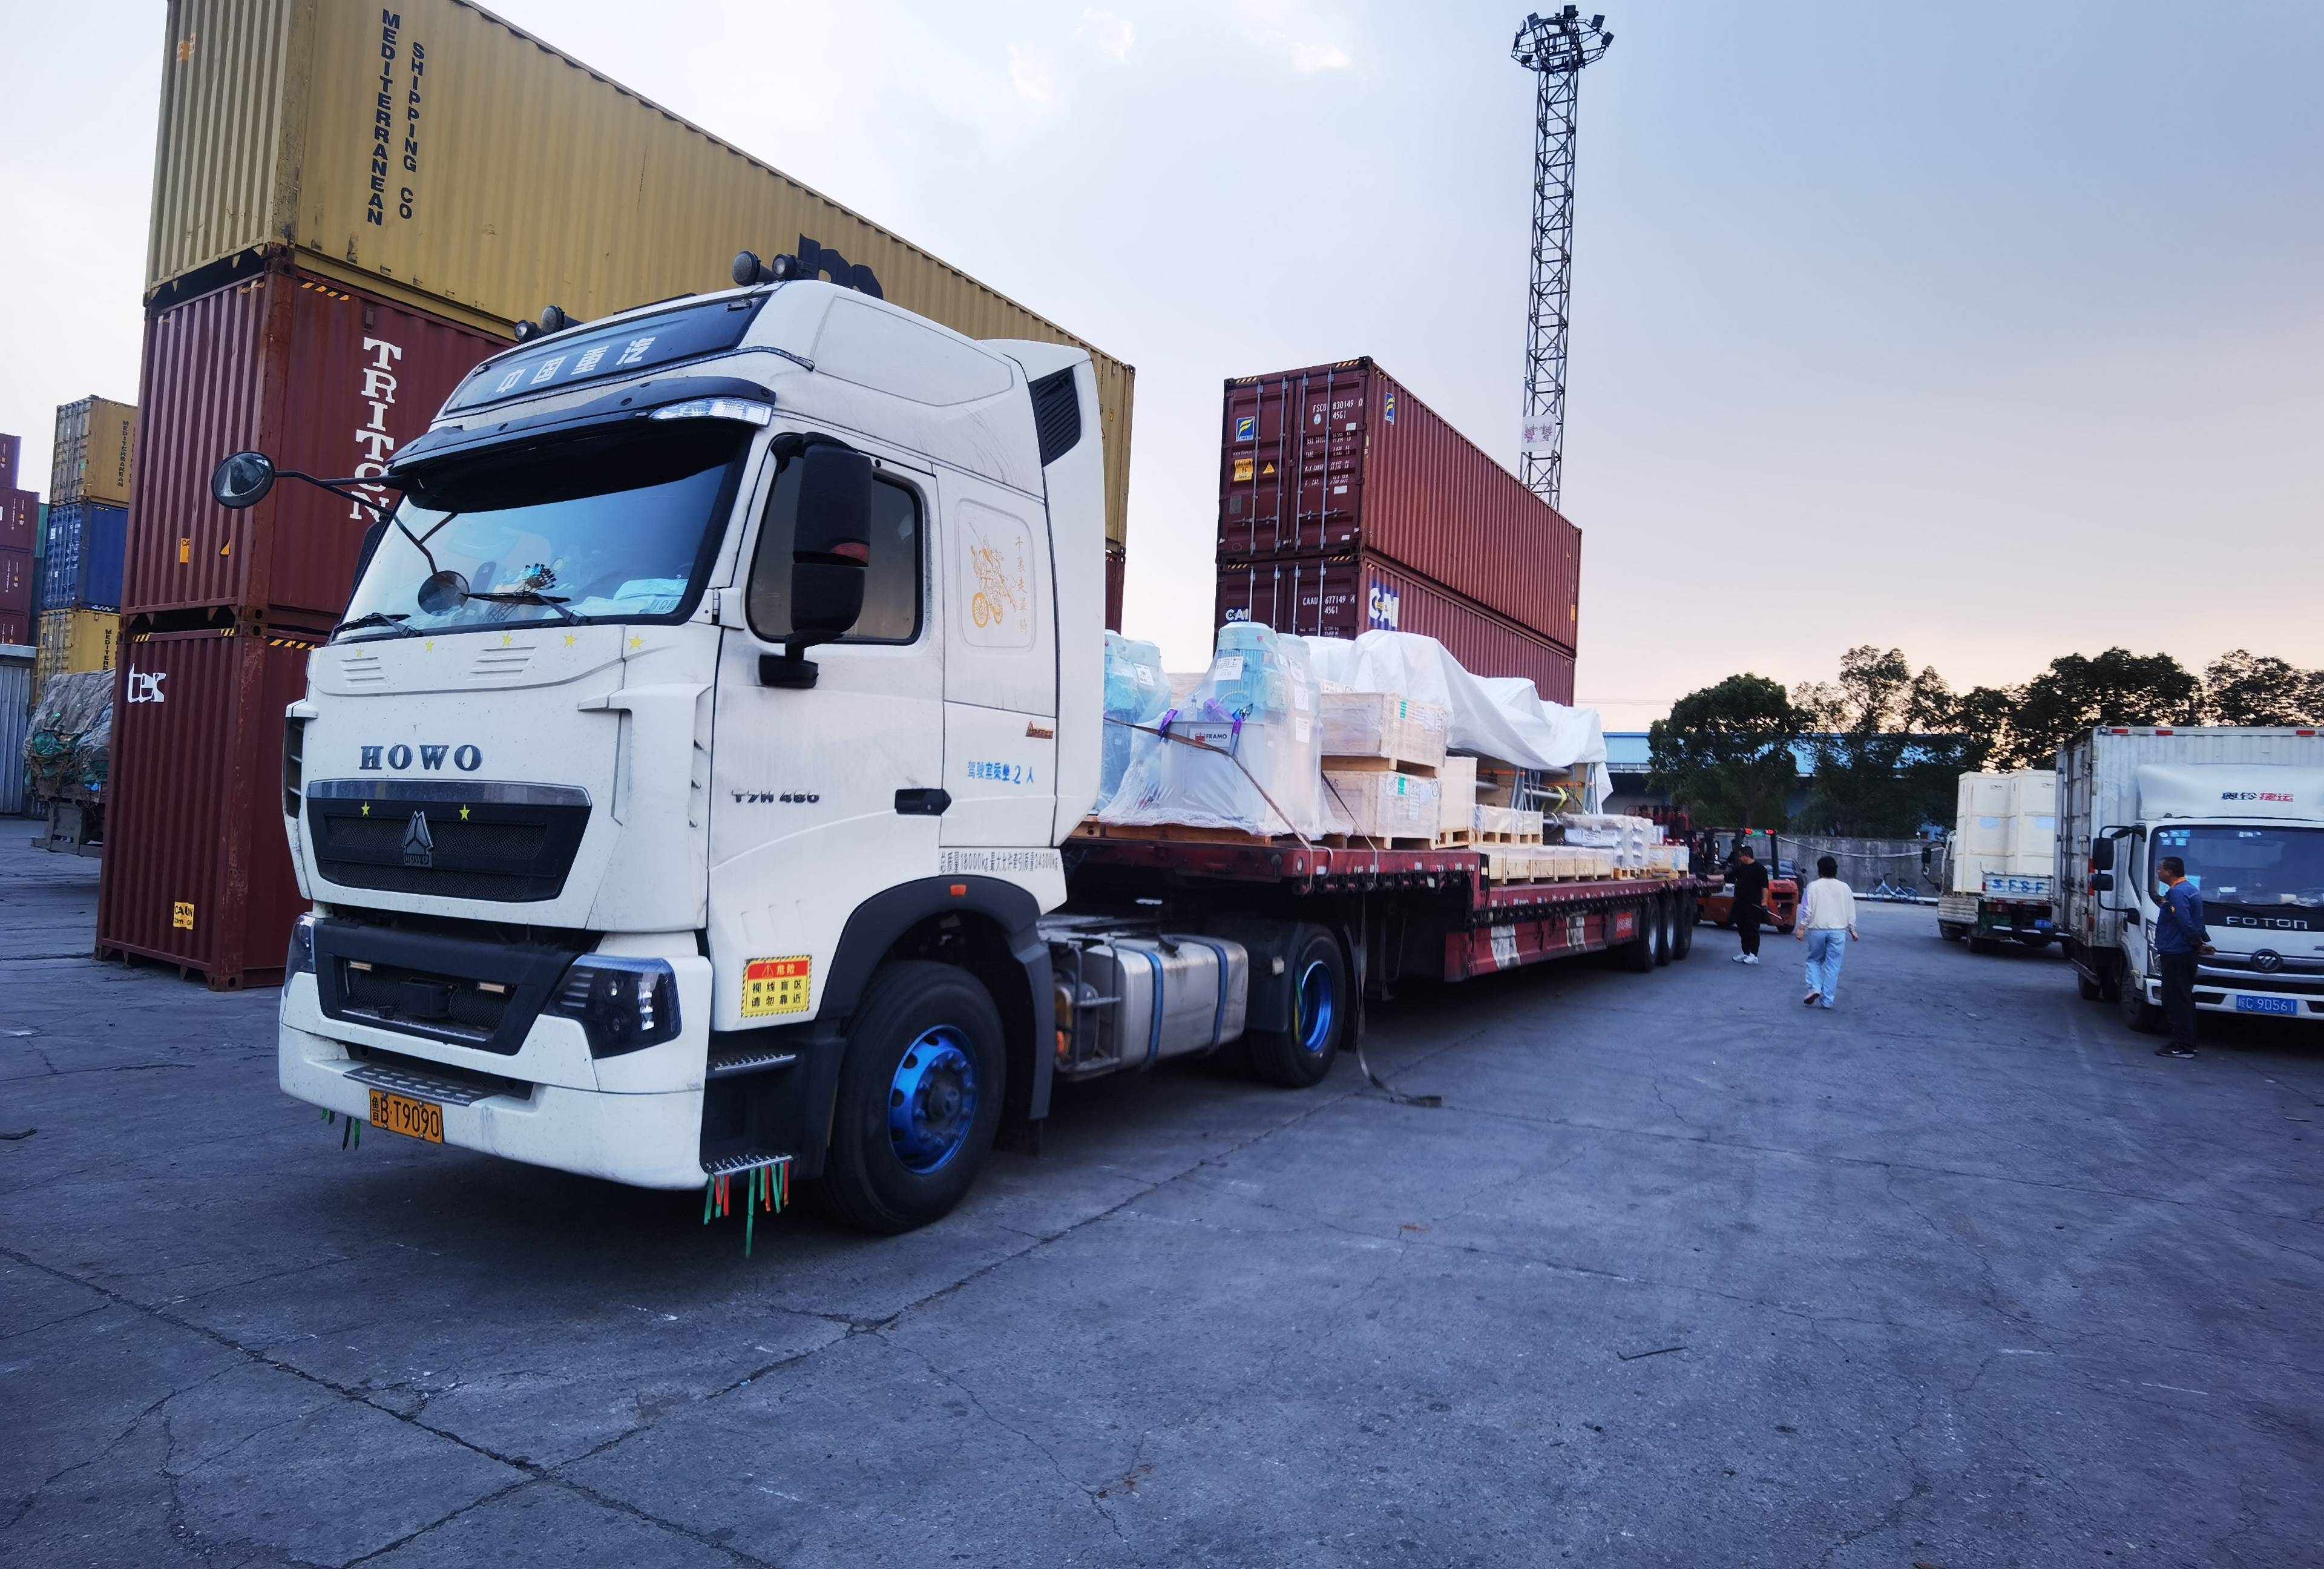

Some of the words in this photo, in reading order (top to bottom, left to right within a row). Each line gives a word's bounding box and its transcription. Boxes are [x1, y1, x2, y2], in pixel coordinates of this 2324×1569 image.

[403, 41, 424, 173] SHIPPING
[367, 8, 401, 226] MEDITERRANEAN
[399, 187, 413, 219] CO
[495, 337, 656, 393] 中国重汽
[1313, 403, 1327, 413] FSCU
[1333, 400, 1354, 410] 830149
[1333, 410, 1347, 419] 45G1
[1302, 597, 1318, 605] CAAU
[1325, 595, 1346, 604] 677149
[1226, 608, 1249, 621] CAI
[1324, 606, 1339, 614] 45G1
[359, 744, 483, 771] HOWO
[2226, 916, 2308, 930] FOTON
[776, 963, 795, 976] 危险
[752, 993, 801, 1007] 请勿靠近
